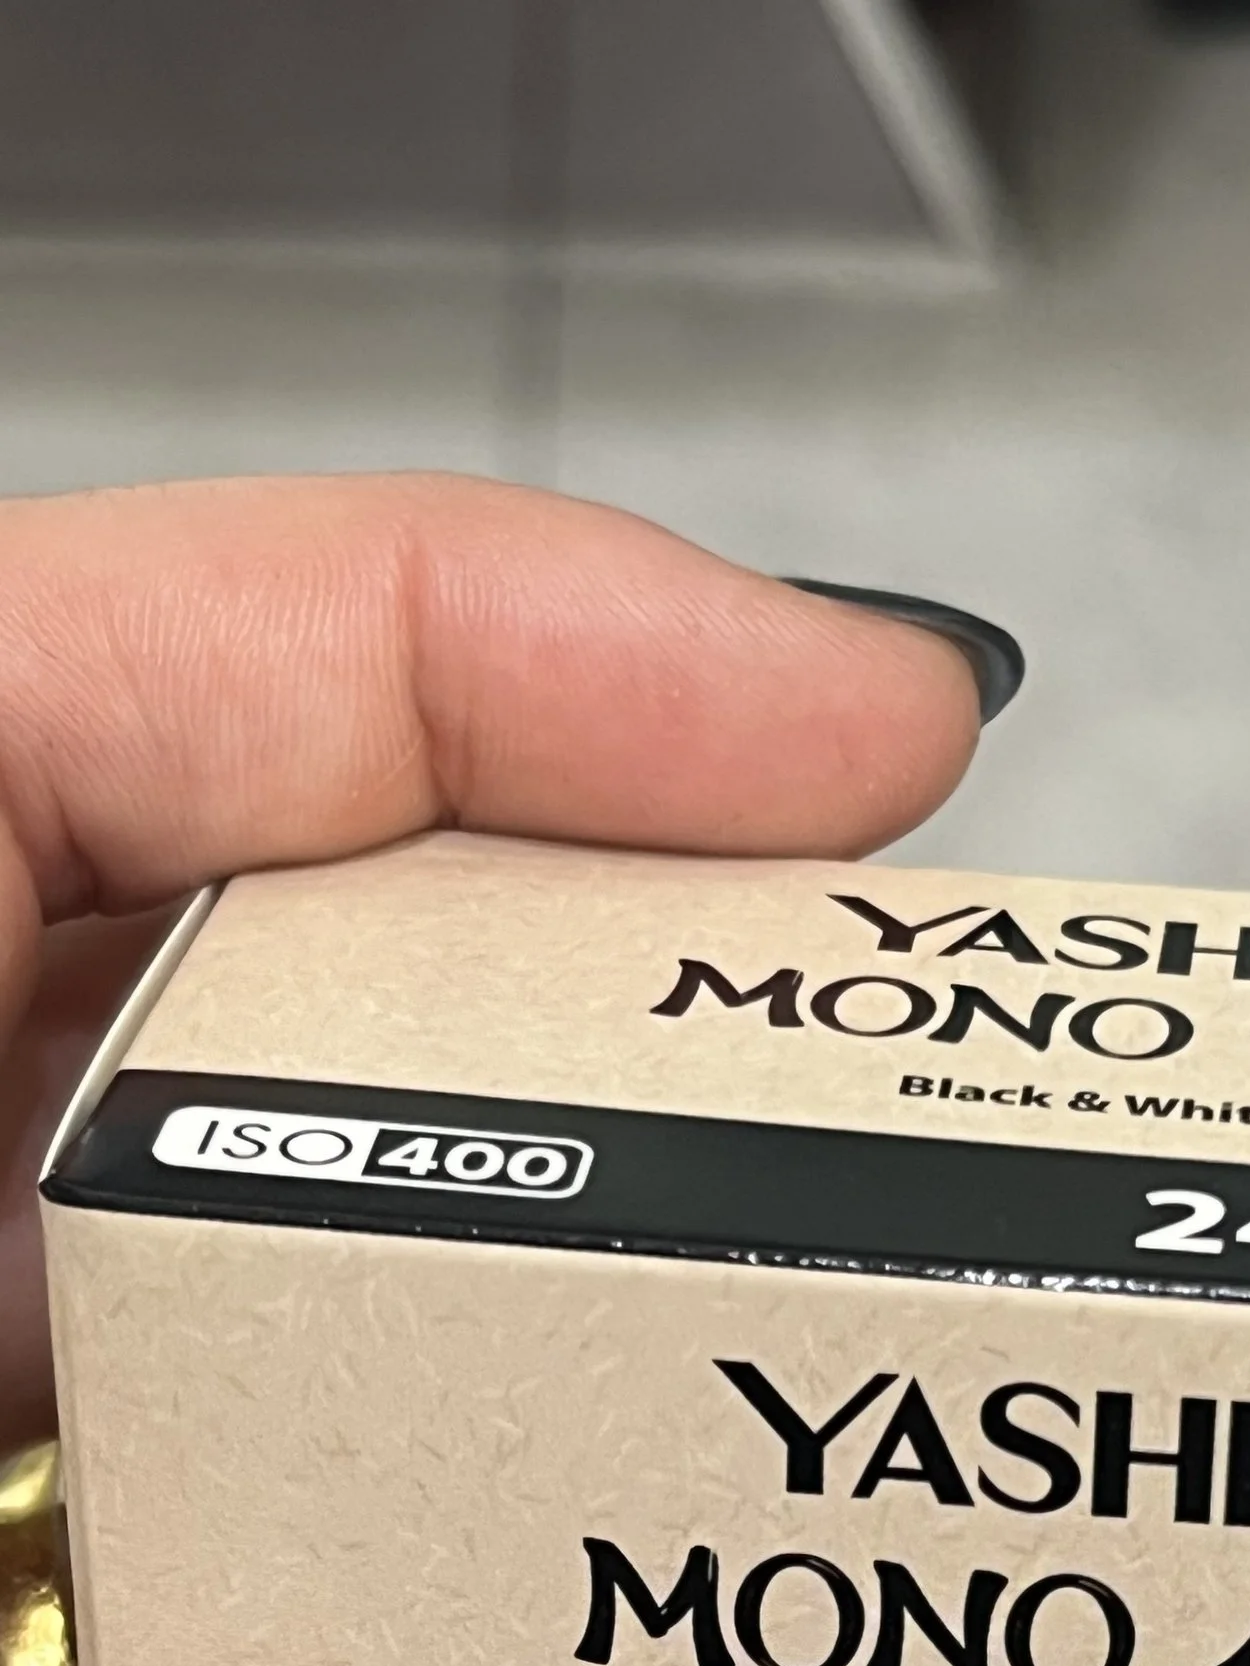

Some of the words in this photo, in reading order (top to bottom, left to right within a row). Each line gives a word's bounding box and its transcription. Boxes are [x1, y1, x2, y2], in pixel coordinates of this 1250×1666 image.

[650, 958, 1194, 1061] MONO
[898, 1073, 1052, 1110] Black
[1068, 1086, 1111, 1113] &
[197, 1120, 353, 1166] ISO
[378, 1136, 568, 1187] 400
